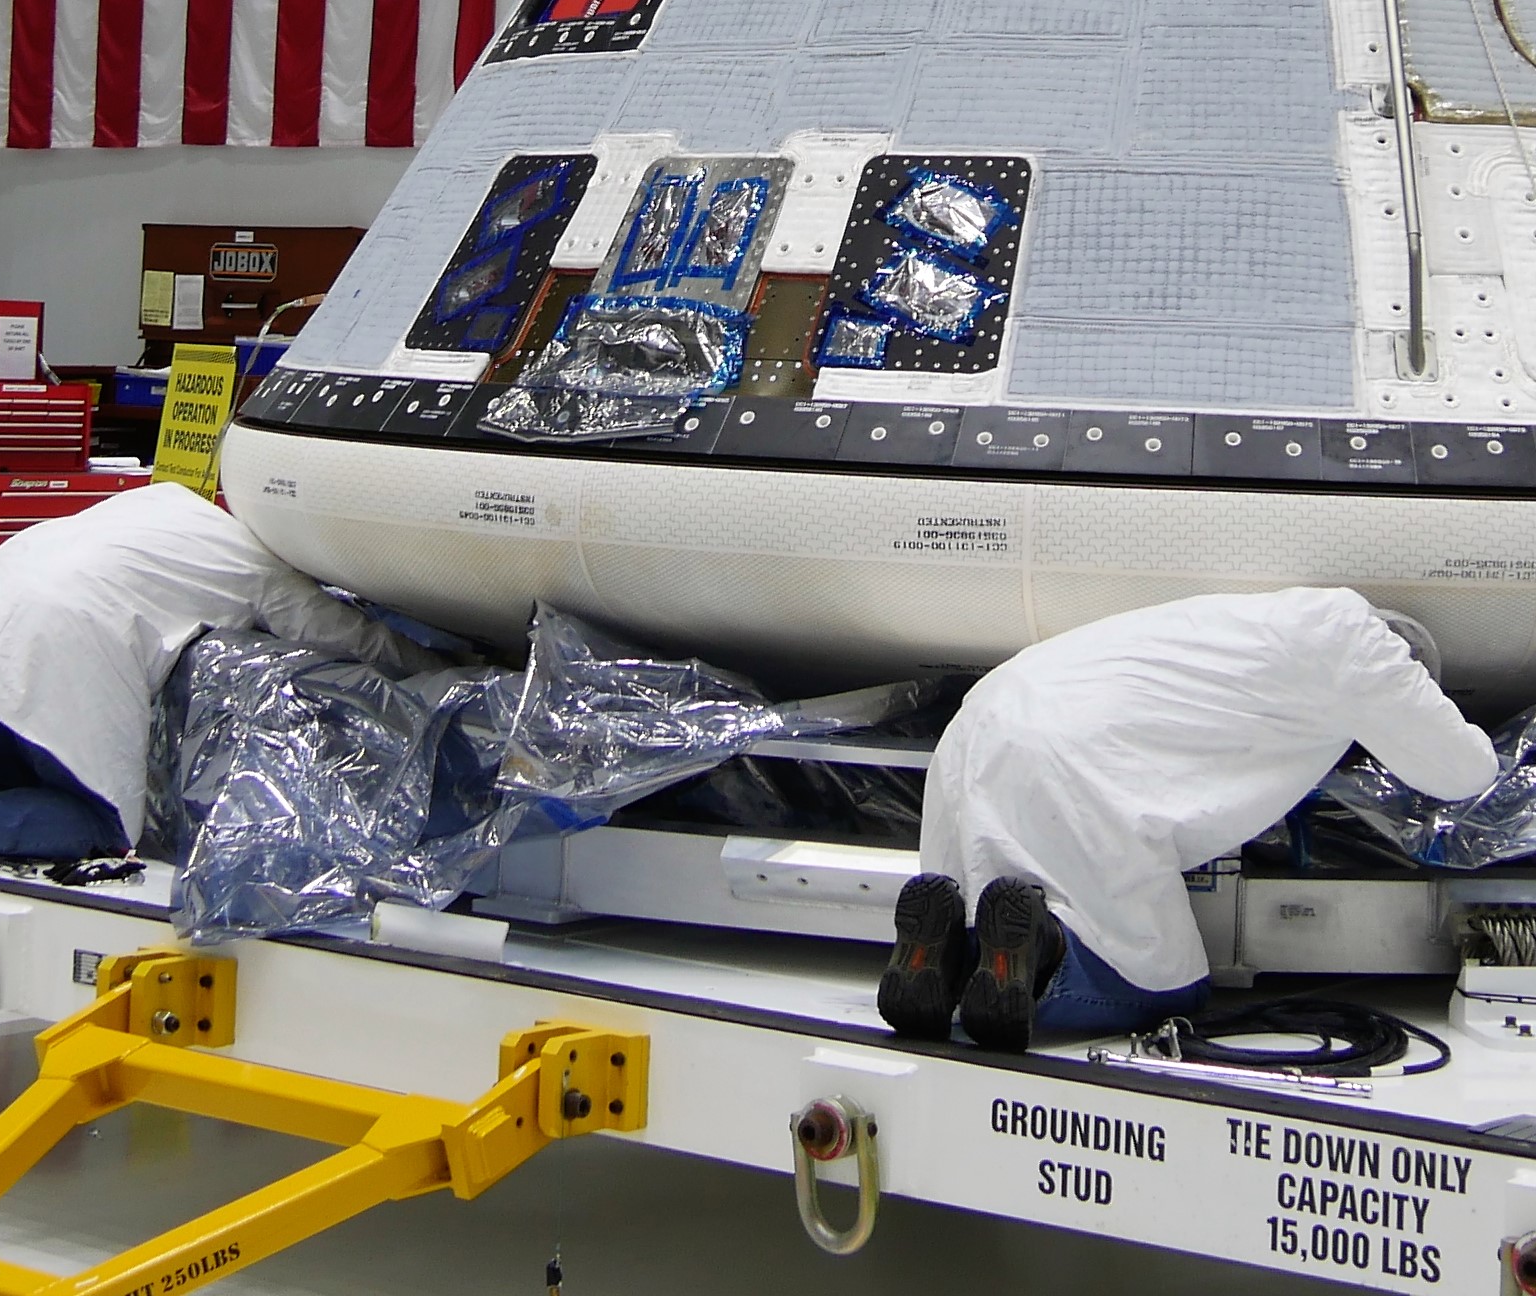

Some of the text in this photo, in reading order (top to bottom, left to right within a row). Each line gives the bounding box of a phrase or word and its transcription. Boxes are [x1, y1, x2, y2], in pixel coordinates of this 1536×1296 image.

[213, 250, 275, 274] JOBOX
[175, 372, 224, 397] HAZARDOUS
[172, 400, 219, 426] OPERATION
[163, 427, 218, 455] IN PROGRESS
[917, 517, 1007, 527] INSTRUMENTED
[991, 1098, 1166, 1162] GROUNDING
[1227, 1118, 1472, 1195] TIE DOWN ONLY
[1038, 1160, 1113, 1205] STUD
[1277, 1173, 1430, 1234] CAPACITY
[161, 1242, 241, 1293] 250LBS
[1267, 1216, 1442, 1283] 15,000 LBS
